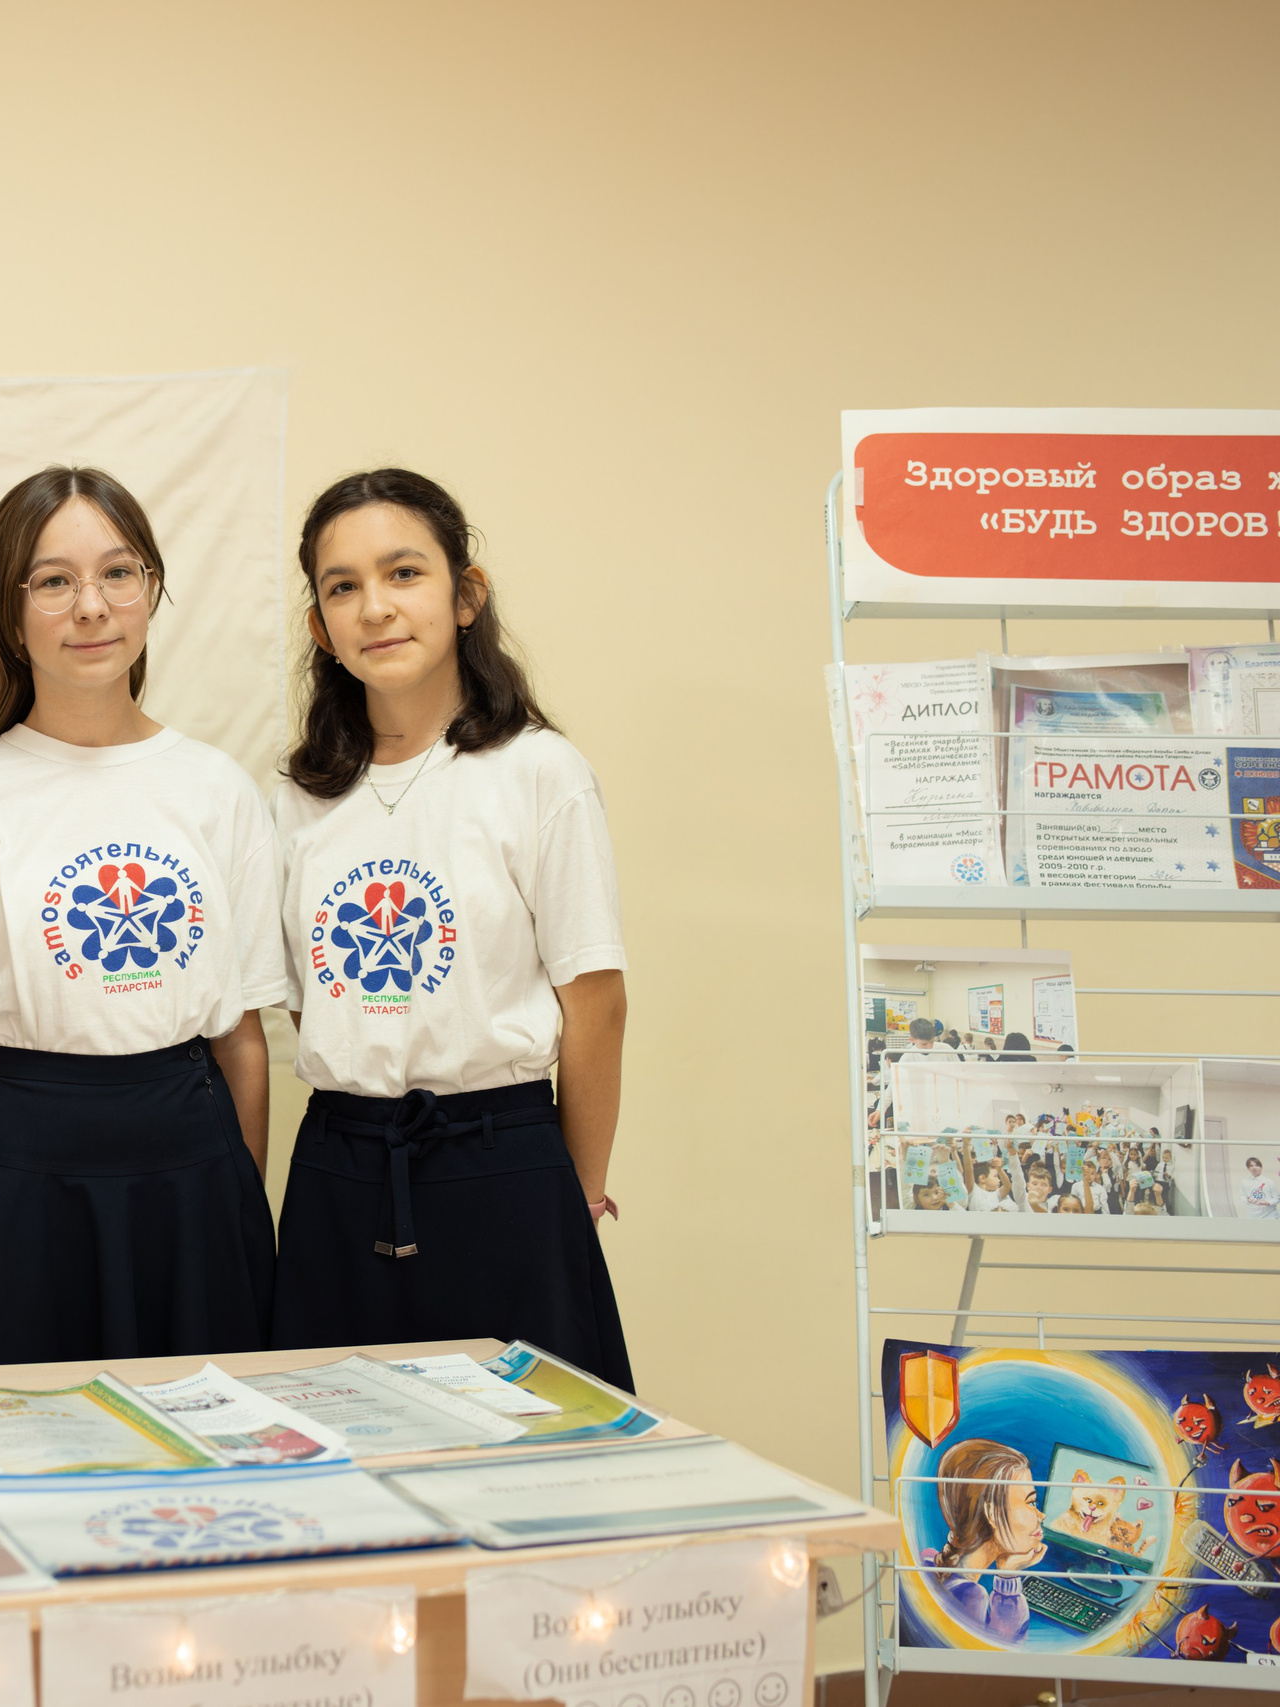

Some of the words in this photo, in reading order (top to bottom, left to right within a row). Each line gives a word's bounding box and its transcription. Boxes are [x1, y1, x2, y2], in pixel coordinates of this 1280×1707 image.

[904, 460, 1097, 495] Здоровый
[1121, 463, 1242, 497] образ
[980, 508, 1097, 539] «БУДЬ
[899, 748, 931, 756] рамках
[1033, 760, 1197, 792] ГРАМОТА
[1034, 791, 1102, 800] награждается
[1036, 823, 1101, 832] Занявший(ая)
[906, 833, 952, 841] номинации
[1043, 833, 1090, 842] Открытых
[1092, 836, 1178, 844] межрегиональных
[890, 841, 939, 850] возрастная
[1036, 844, 1107, 853] соревнованиях
[1037, 854, 1065, 862] среди
[1038, 862, 1089, 870] 2009-2010
[1047, 871, 1086, 879] весовой
[1087, 873, 1137, 882] категории
[102, 969, 162, 983] РЕСПУБЛИКА
[103, 979, 163, 994] ТАТАРСТАН
[361, 994, 412, 1003] РЕСПУБЛИ
[531, 1610, 634, 1641] Вози
[640, 1590, 744, 1633] улыбку
[232, 1643, 348, 1686] улыбку
[522, 1658, 591, 1693] (Они
[599, 1631, 767, 1678] бесплатные)
